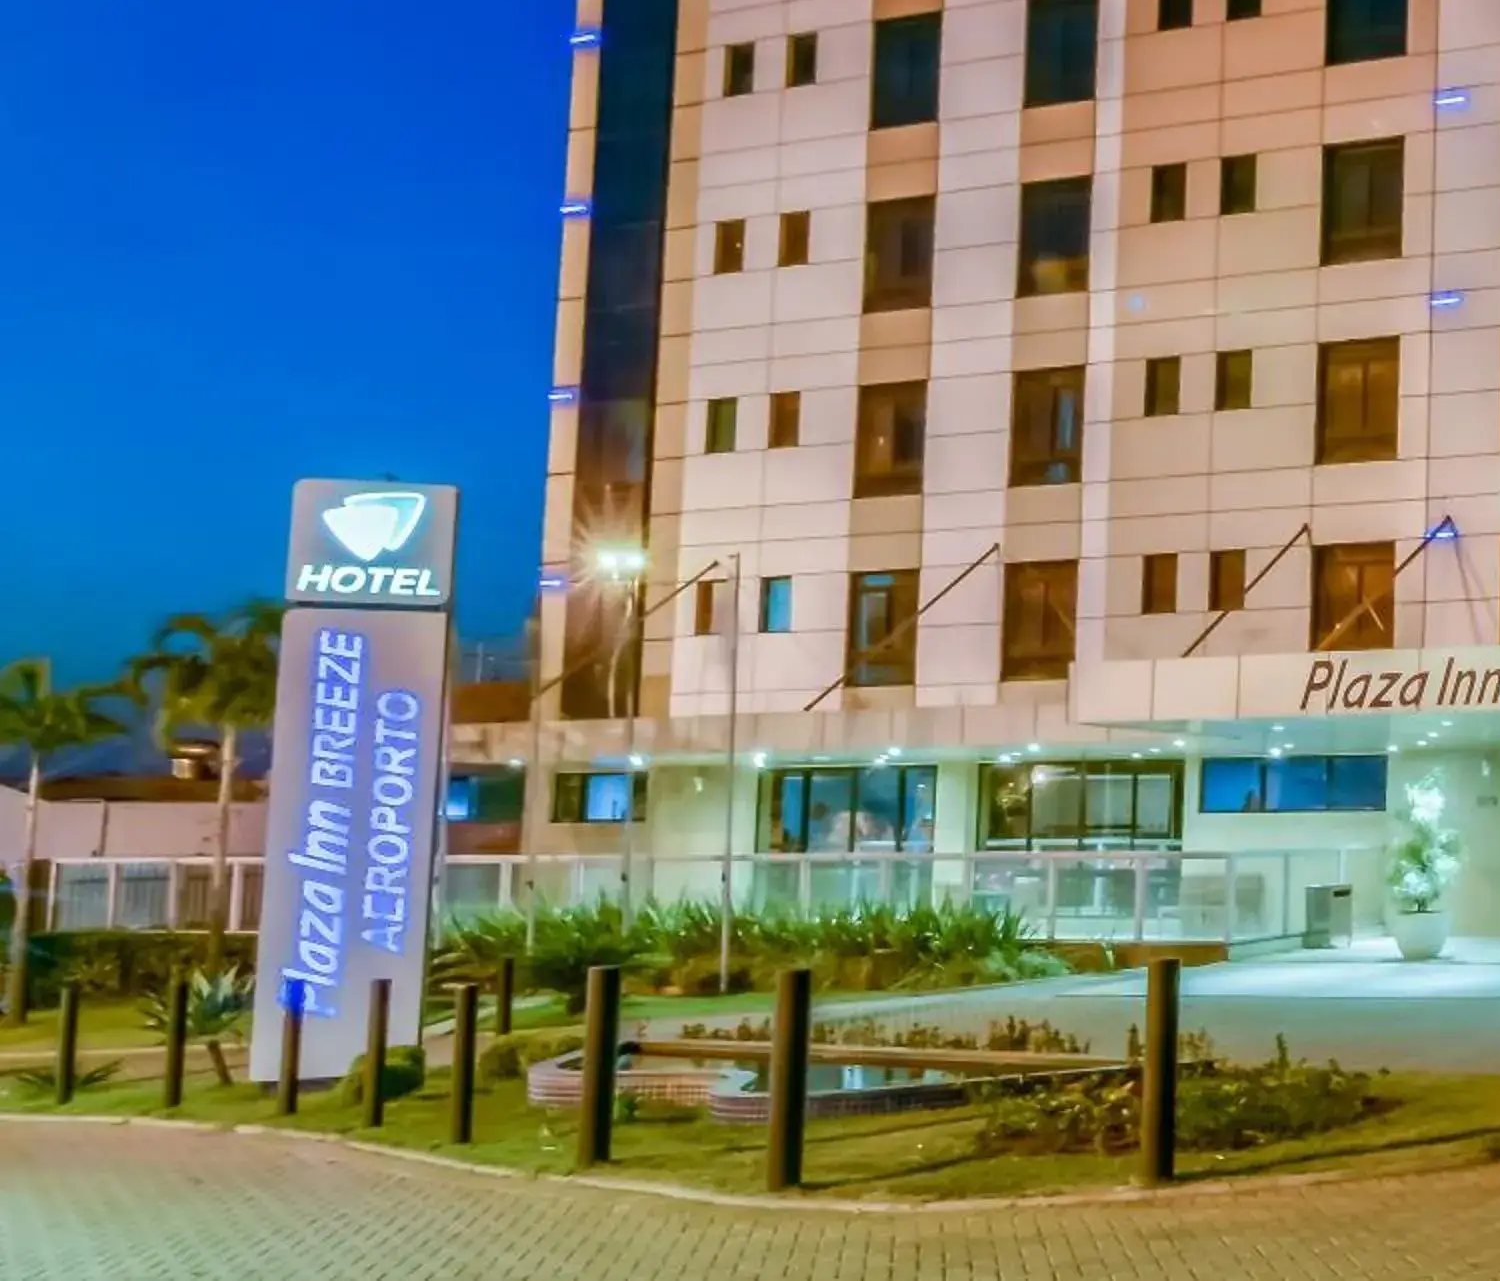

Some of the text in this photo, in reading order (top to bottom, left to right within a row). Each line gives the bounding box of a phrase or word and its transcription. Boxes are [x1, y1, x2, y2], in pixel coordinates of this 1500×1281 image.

[296, 564, 440, 596] HOTEL
[312, 629, 363, 789] BREEZE
[1299, 659, 1430, 710] Plaza
[289, 799, 352, 875] Inn
[361, 689, 419, 952] AEROPORTO
